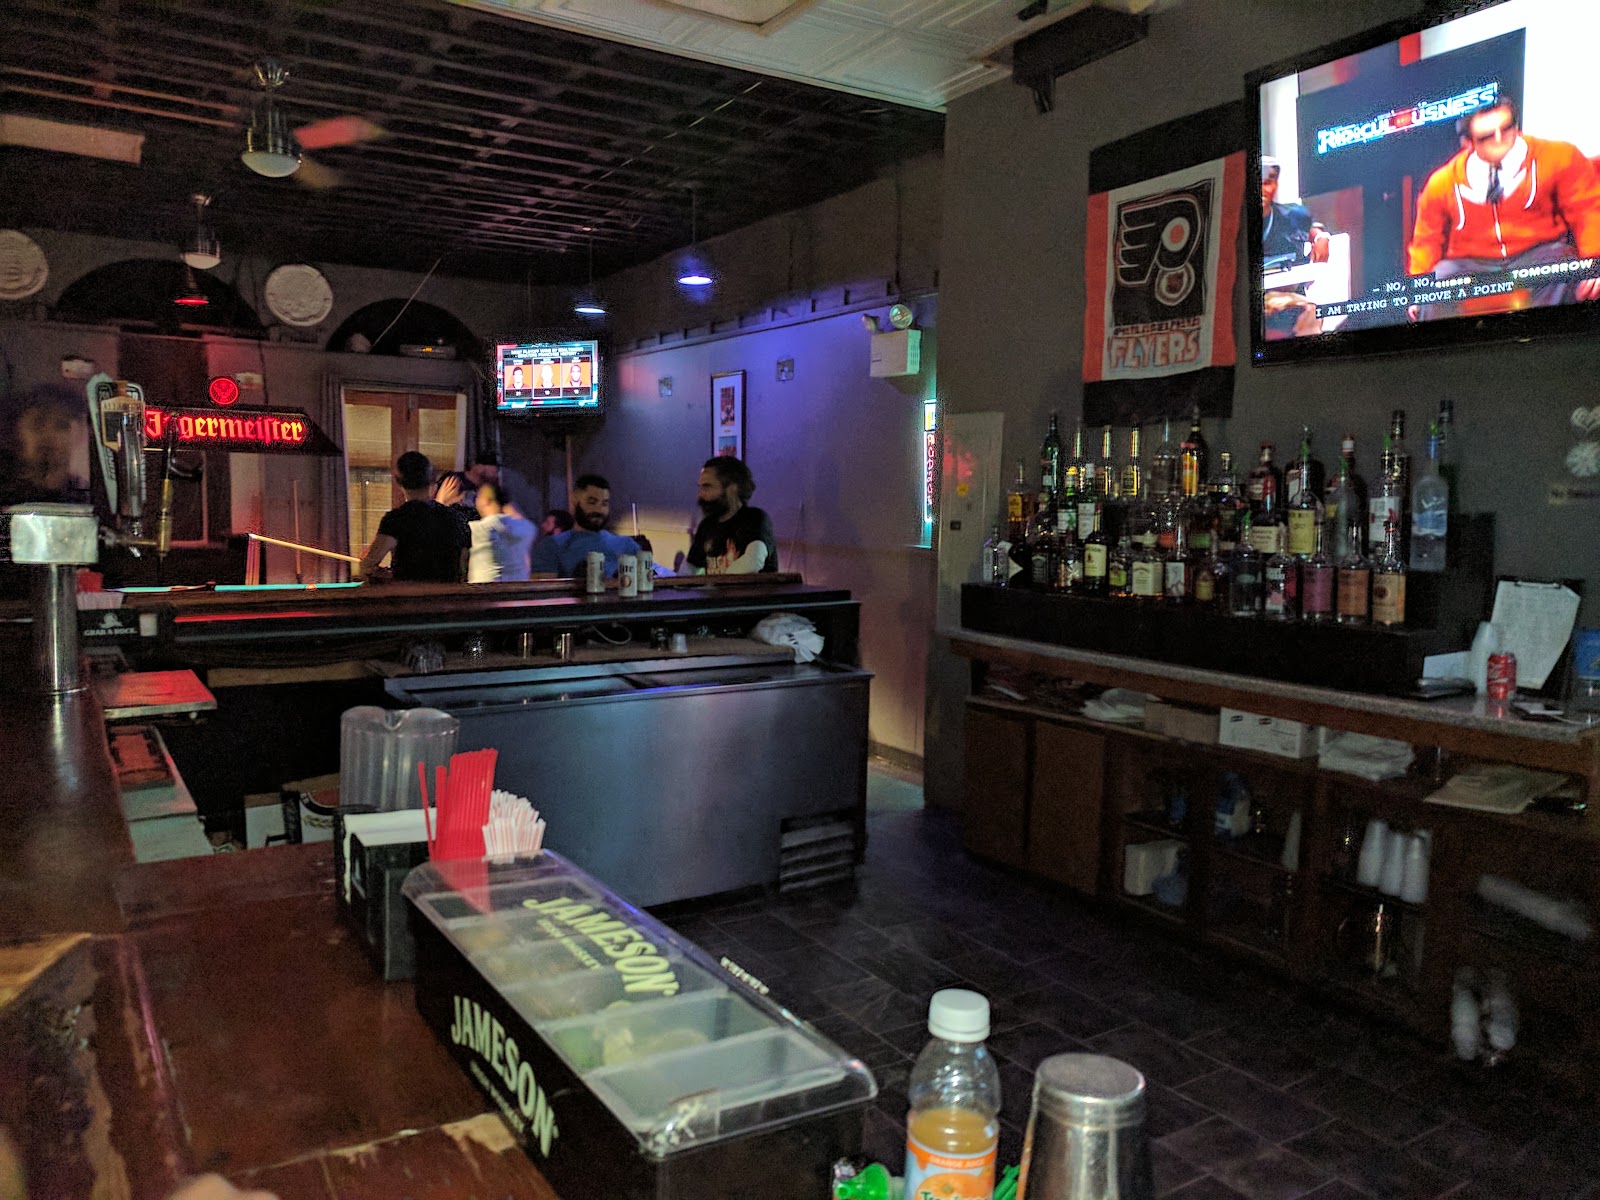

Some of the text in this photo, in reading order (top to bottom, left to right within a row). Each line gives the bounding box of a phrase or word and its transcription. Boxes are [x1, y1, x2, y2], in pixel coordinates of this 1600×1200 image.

[1386, 281, 1406, 292] NO,
[1414, 277, 1434, 288] NO,
[1512, 258, 1593, 279] TOMORROW
[1316, 308, 1322, 317] I
[1327, 305, 1342, 315] AM
[1346, 300, 1388, 313] TRYING
[1393, 296, 1408, 307] TO
[1414, 289, 1451, 304] PROVE
[1457, 288, 1467, 298] A
[1474, 281, 1514, 296] POINT
[1108, 329, 1200, 369] FLYERS
[522, 897, 680, 996] JAMESON
[451, 995, 559, 1159] JAMESON
